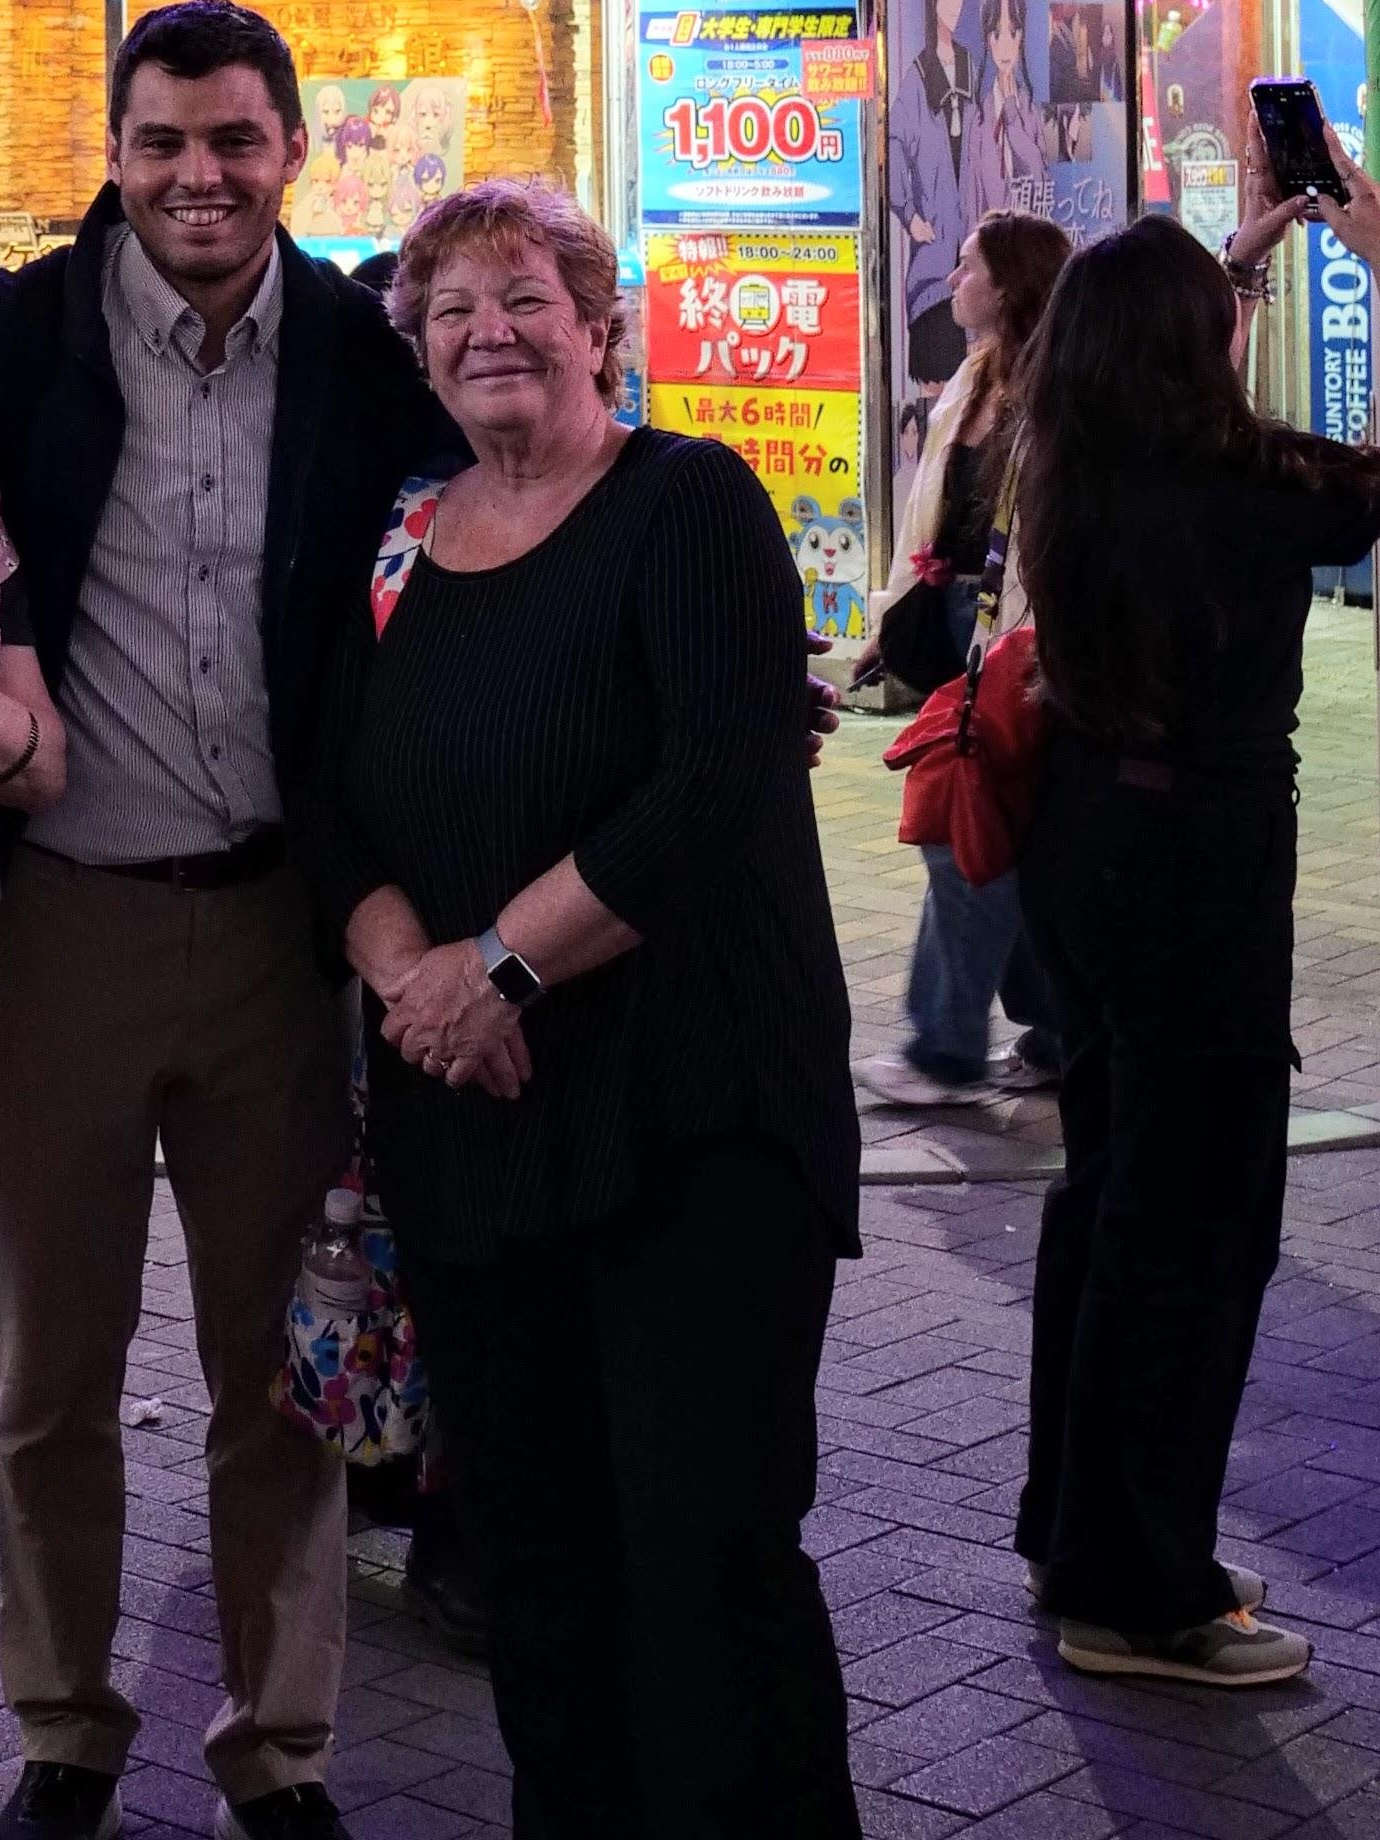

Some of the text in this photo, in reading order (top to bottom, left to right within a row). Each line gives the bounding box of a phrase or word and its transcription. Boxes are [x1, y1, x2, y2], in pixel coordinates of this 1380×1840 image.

[670, 100, 839, 164] 1,100円
[697, 332, 810, 382] パック
[702, 433, 849, 479] 時間分の
